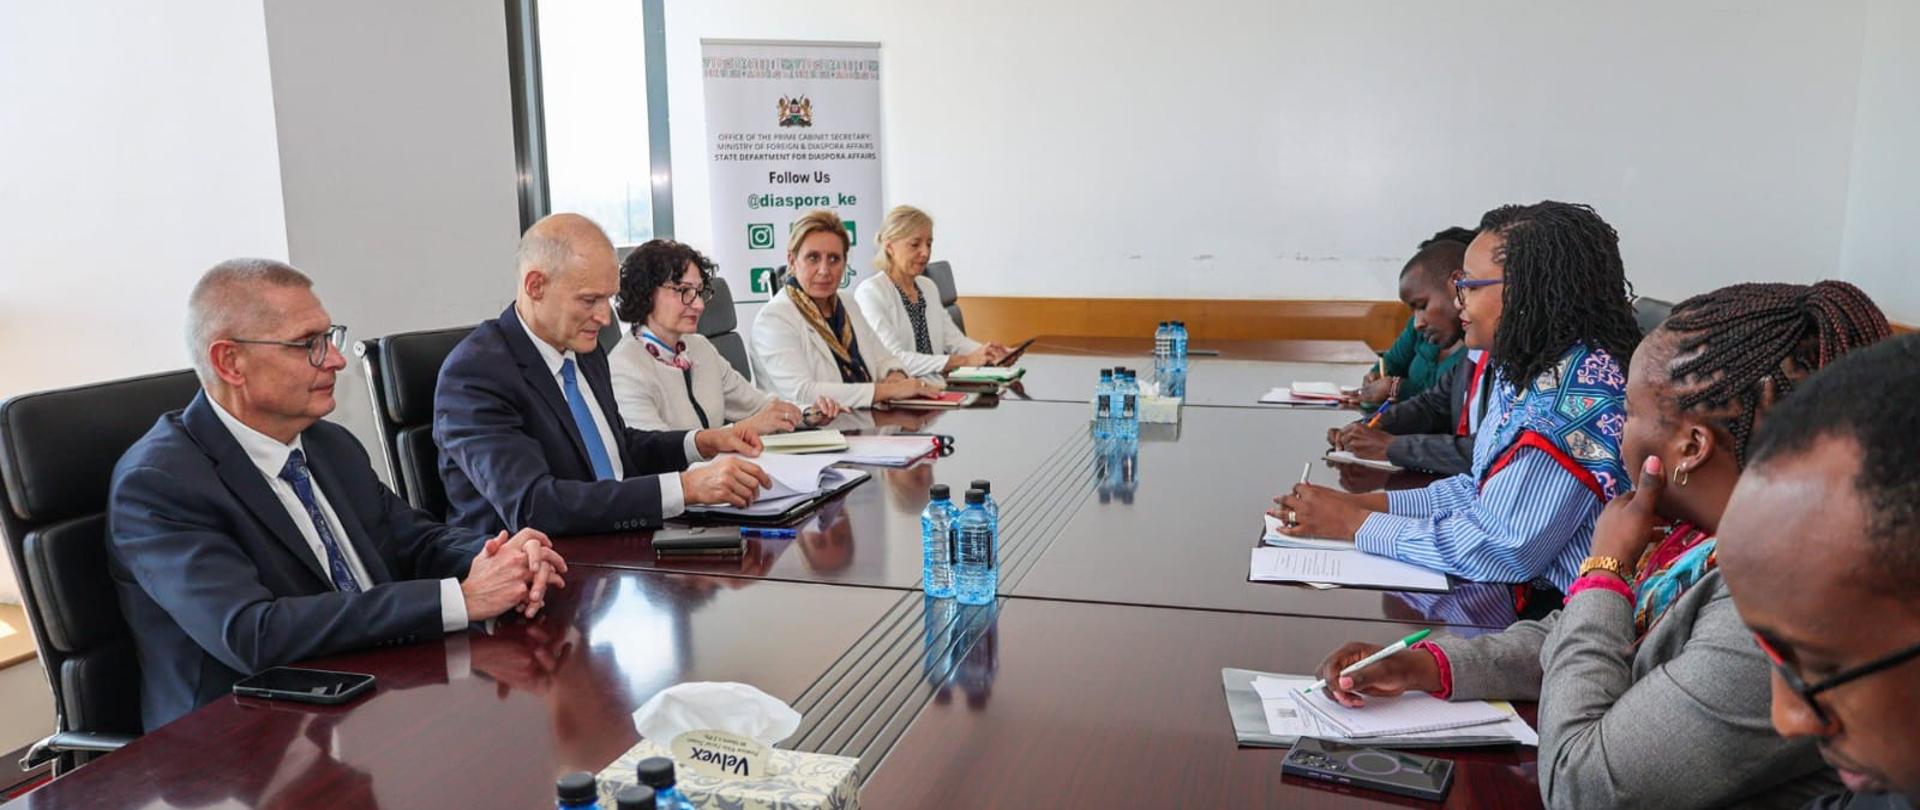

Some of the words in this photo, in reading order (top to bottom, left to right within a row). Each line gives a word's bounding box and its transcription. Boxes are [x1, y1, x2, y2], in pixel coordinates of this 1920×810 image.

[718, 133, 743, 141] OFFICE
[746, 133, 756, 141] OF
[757, 133, 771, 141] THE
[754, 142, 764, 150] OF
[800, 142, 806, 150] &
[808, 142, 844, 150] DIASPORA
[846, 142, 874, 150] AFFAIRS
[714, 153, 737, 161] STATE
[739, 153, 789, 161] DEPARTMENT
[791, 153, 806, 161] FOR
[808, 152, 845, 161] DIASPORA
[847, 152, 876, 160] AFFAIRS
[769, 171, 810, 184] Follow
[814, 171, 831, 183] Us
[748, 192, 857, 209] @diaspora_ke
[690, 747, 749, 776] Velvex
